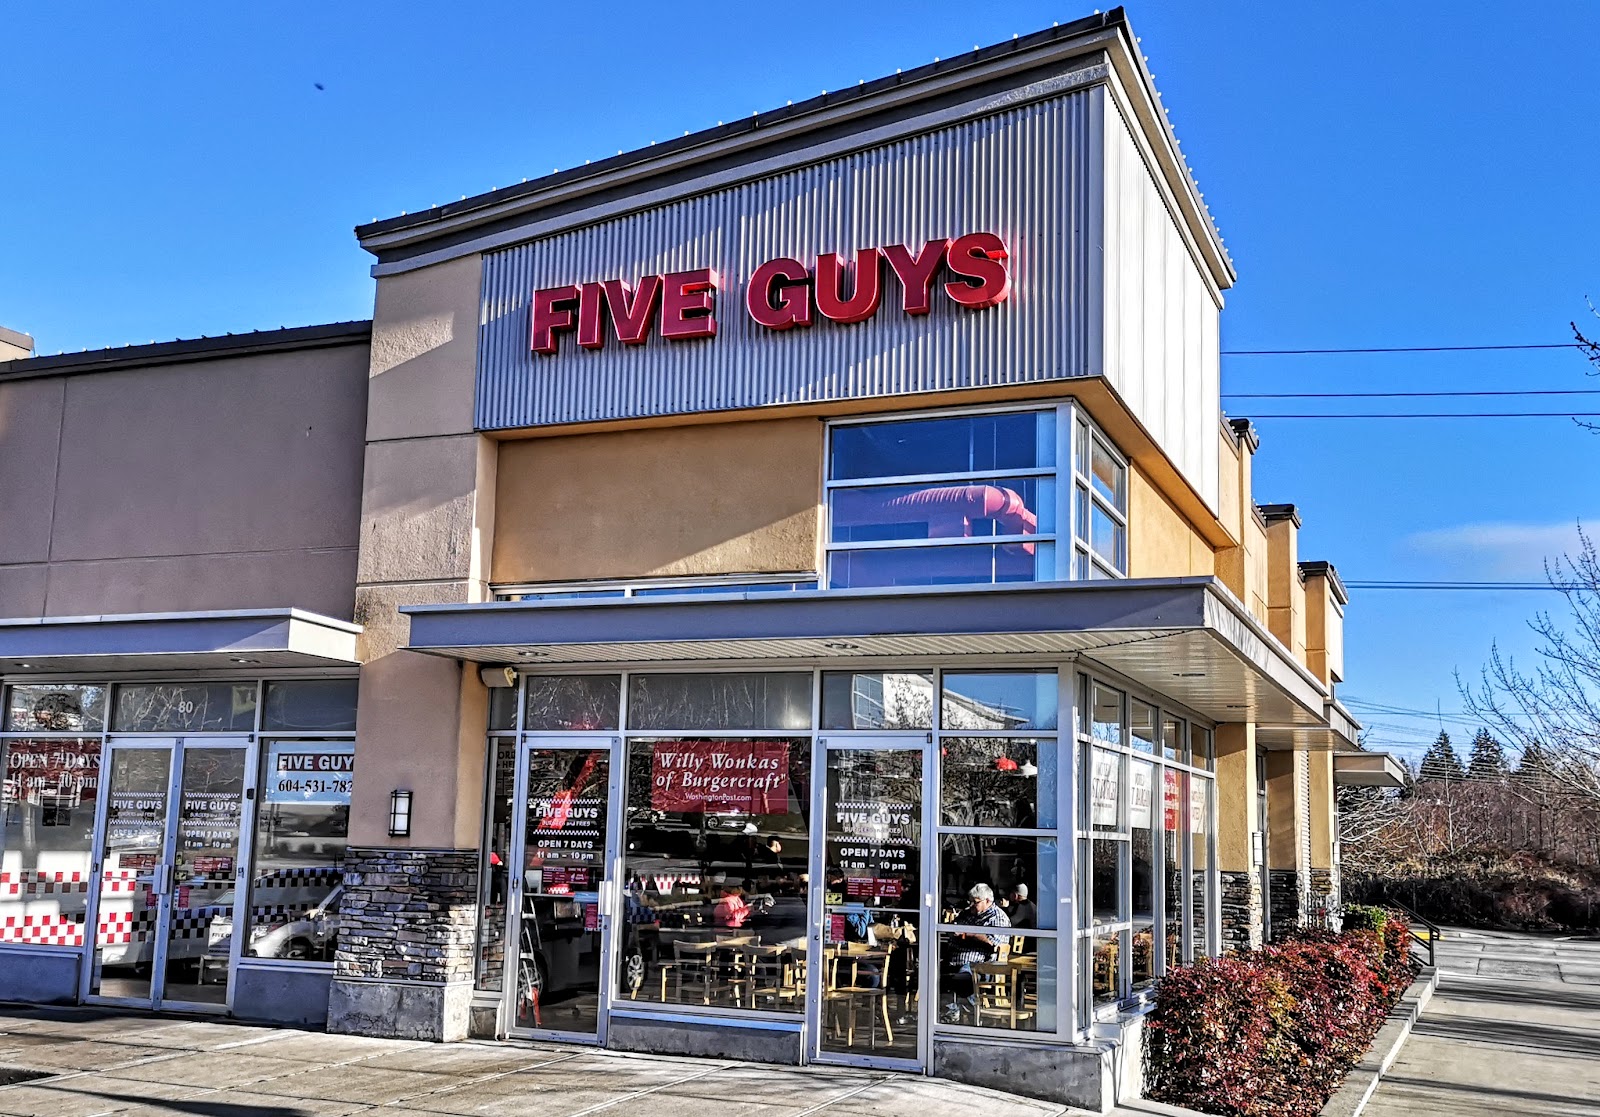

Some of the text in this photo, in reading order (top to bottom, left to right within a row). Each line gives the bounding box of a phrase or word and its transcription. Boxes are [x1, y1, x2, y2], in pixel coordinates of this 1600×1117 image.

[530, 231, 1011, 355] FIVE GUYS
[178, 701, 193, 713] 80
[10, 752, 100, 769] OPEN 7 DAYS
[279, 755, 314, 770] FIVE
[710, 753, 779, 769] Wonkas
[27, 776, 45, 788] am
[77, 776, 97, 793] pm
[656, 770, 786, 793] of Burgercraft"
[684, 792, 752, 801] WashingtonPost.com
[112, 800, 163, 810] FIVE GUYS
[185, 801, 237, 811] FIVE GUYS
[535, 807, 598, 819] FIVE GUYS
[836, 812, 911, 825] FIVE GUYS
[185, 830, 206, 838] OPEN
[207, 830, 212, 838] 7
[538, 840, 594, 849] OPEN 7 DAYS
[840, 848, 906, 858] OPEN 7 DAYS
[839, 860, 849, 868] 11
[879, 861, 890, 869] 10
[892, 863, 907, 871] pm
